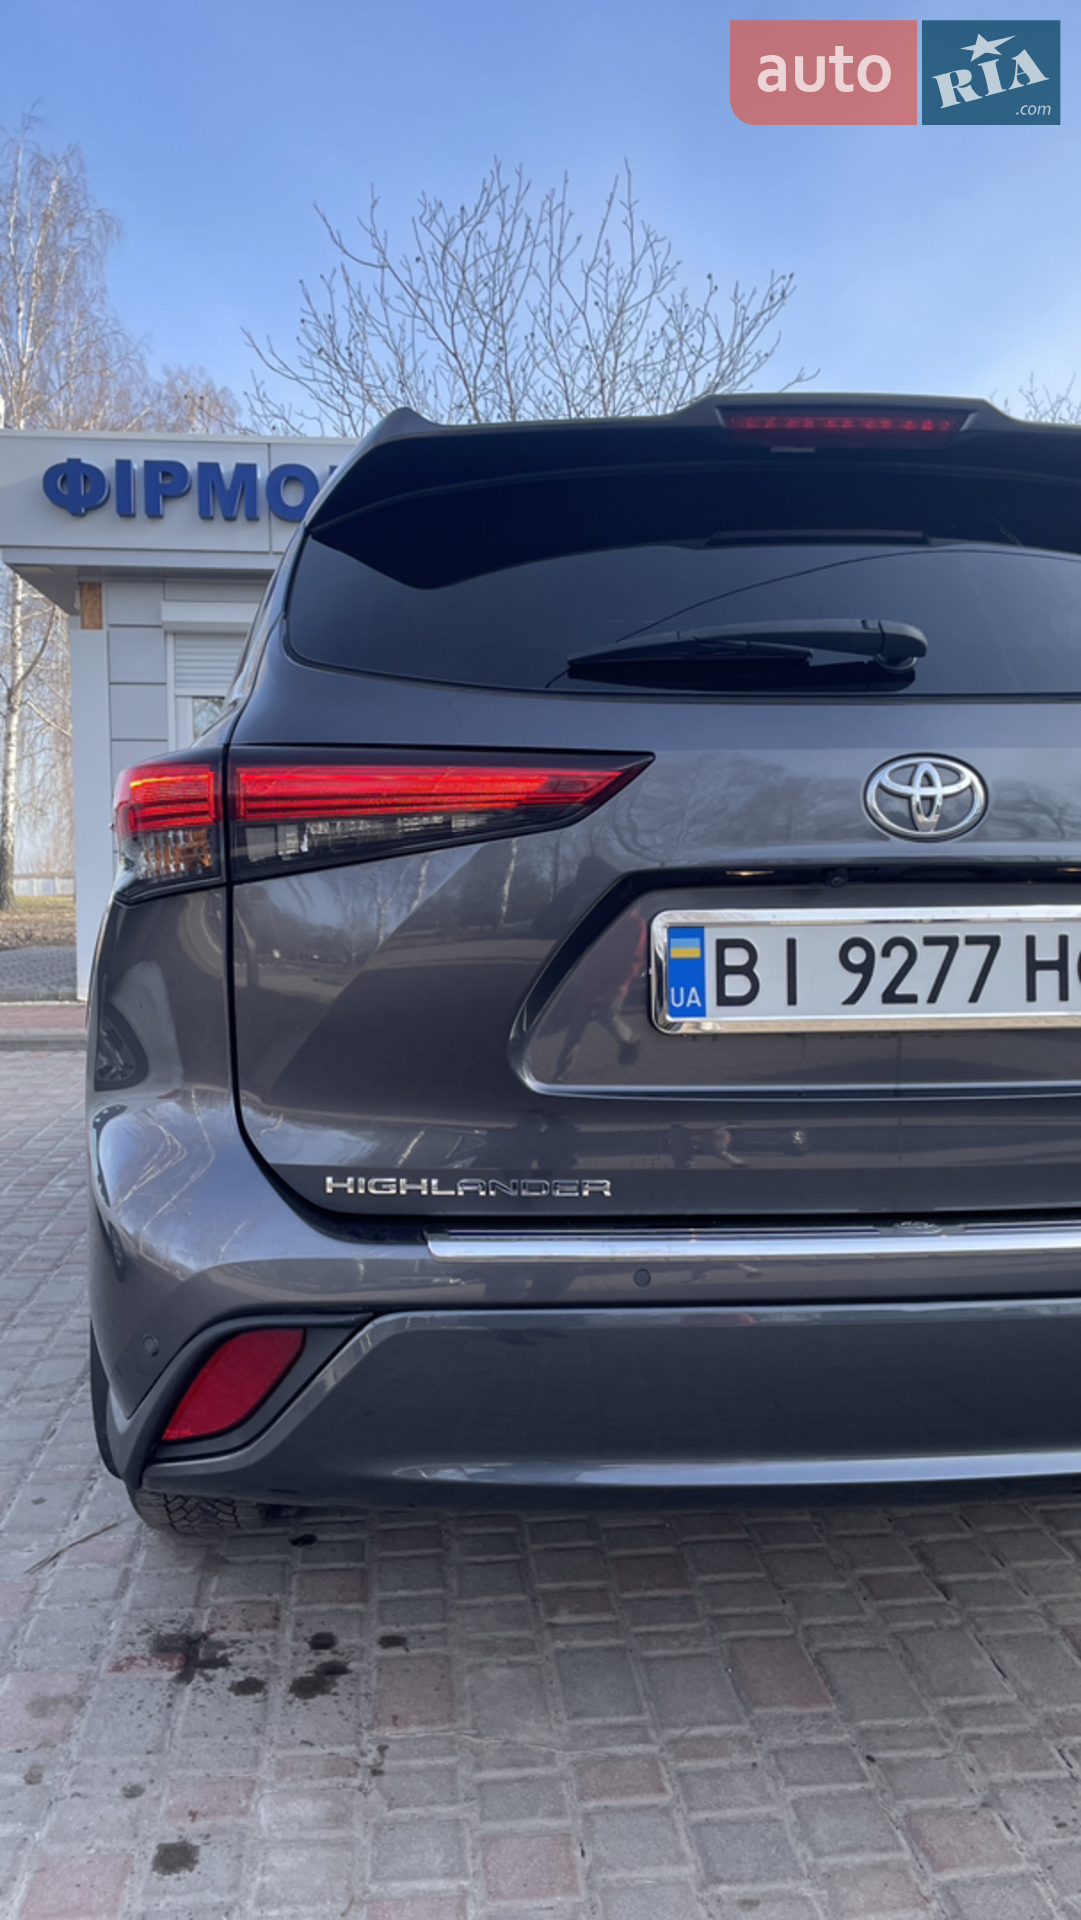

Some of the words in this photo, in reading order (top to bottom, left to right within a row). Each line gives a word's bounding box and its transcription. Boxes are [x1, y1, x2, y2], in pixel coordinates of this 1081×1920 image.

[42, 458, 338, 522] ФІРМО
[715, 937, 797, 1007] BI
[838, 934, 1001, 1006] 9277
[1025, 933, 1081, 1003] H
[670, 987, 702, 1008] UA
[325, 1175, 612, 1198] HIGHLANDER
